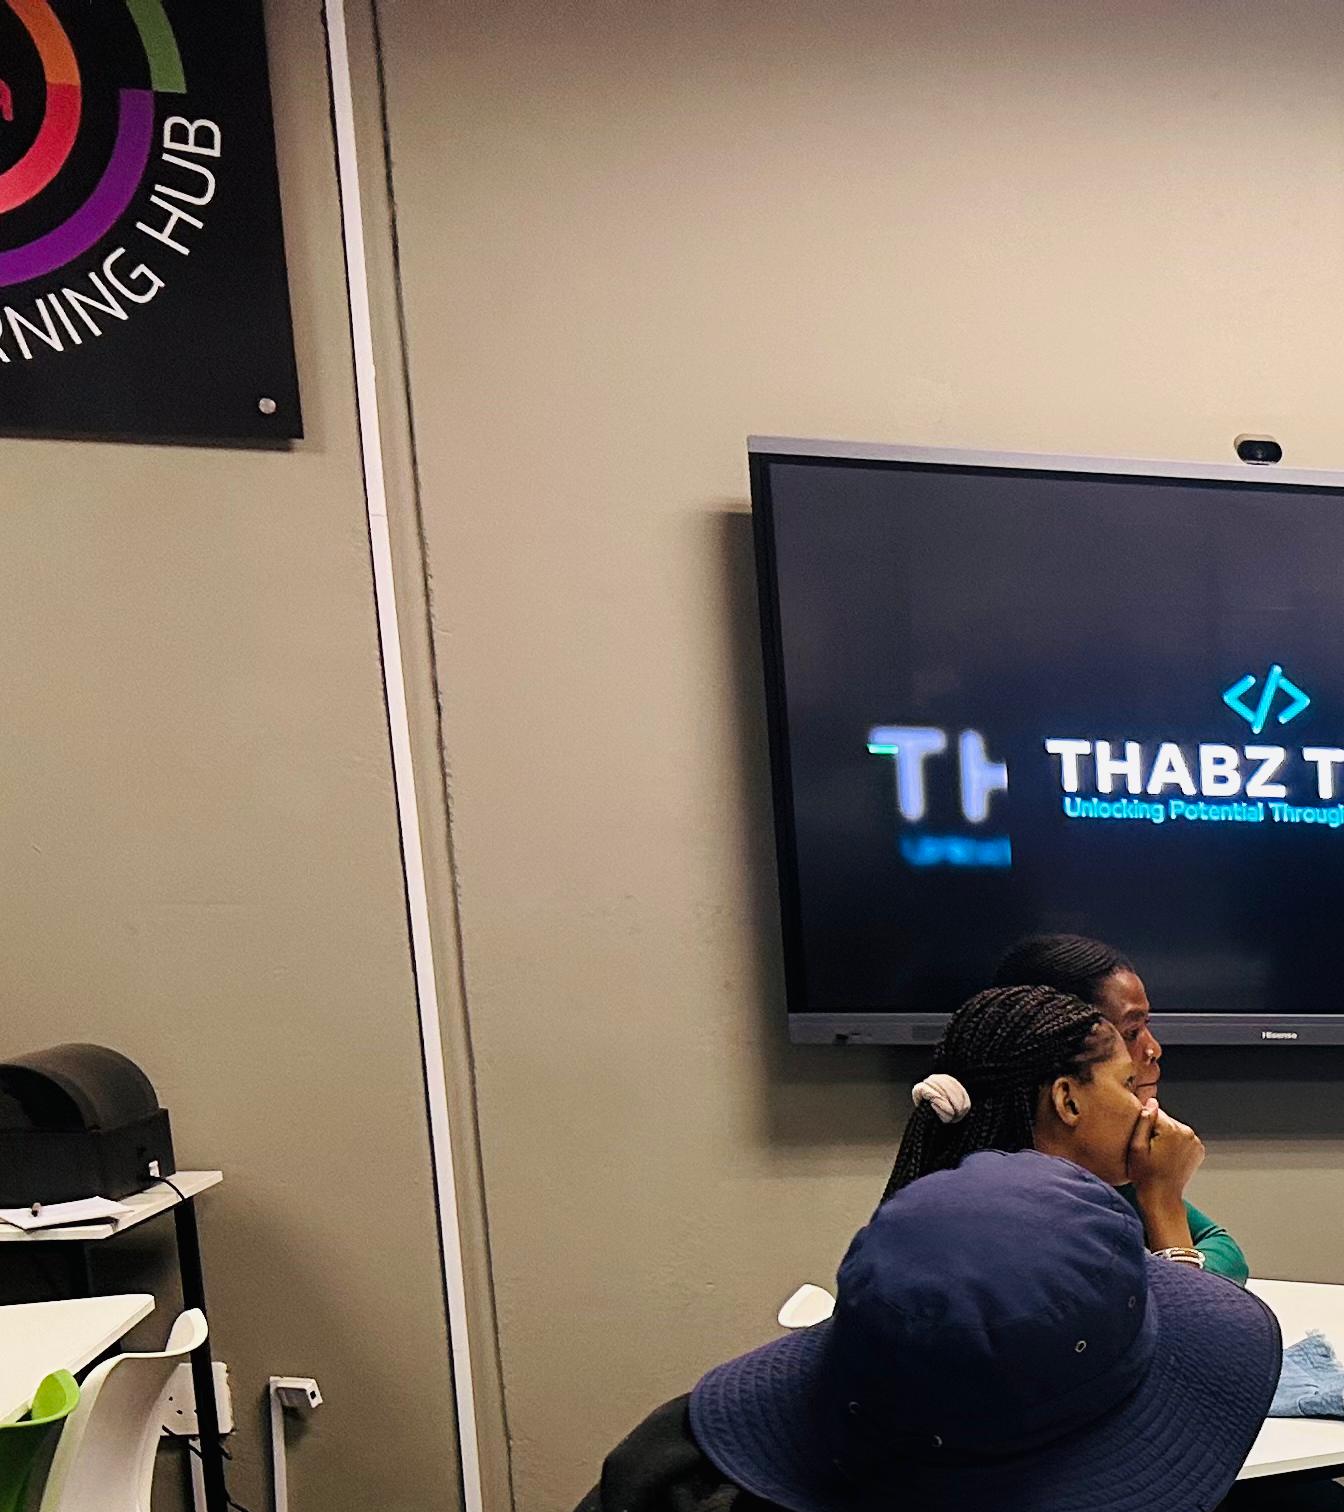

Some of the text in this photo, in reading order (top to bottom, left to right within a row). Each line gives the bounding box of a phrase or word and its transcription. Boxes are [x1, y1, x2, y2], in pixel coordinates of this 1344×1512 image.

[0, 115, 221, 363] NING HUB
[1045, 738, 1287, 799] THABZ
[1063, 796, 1165, 824] Unlocking
[1169, 799, 1264, 823] Potential
